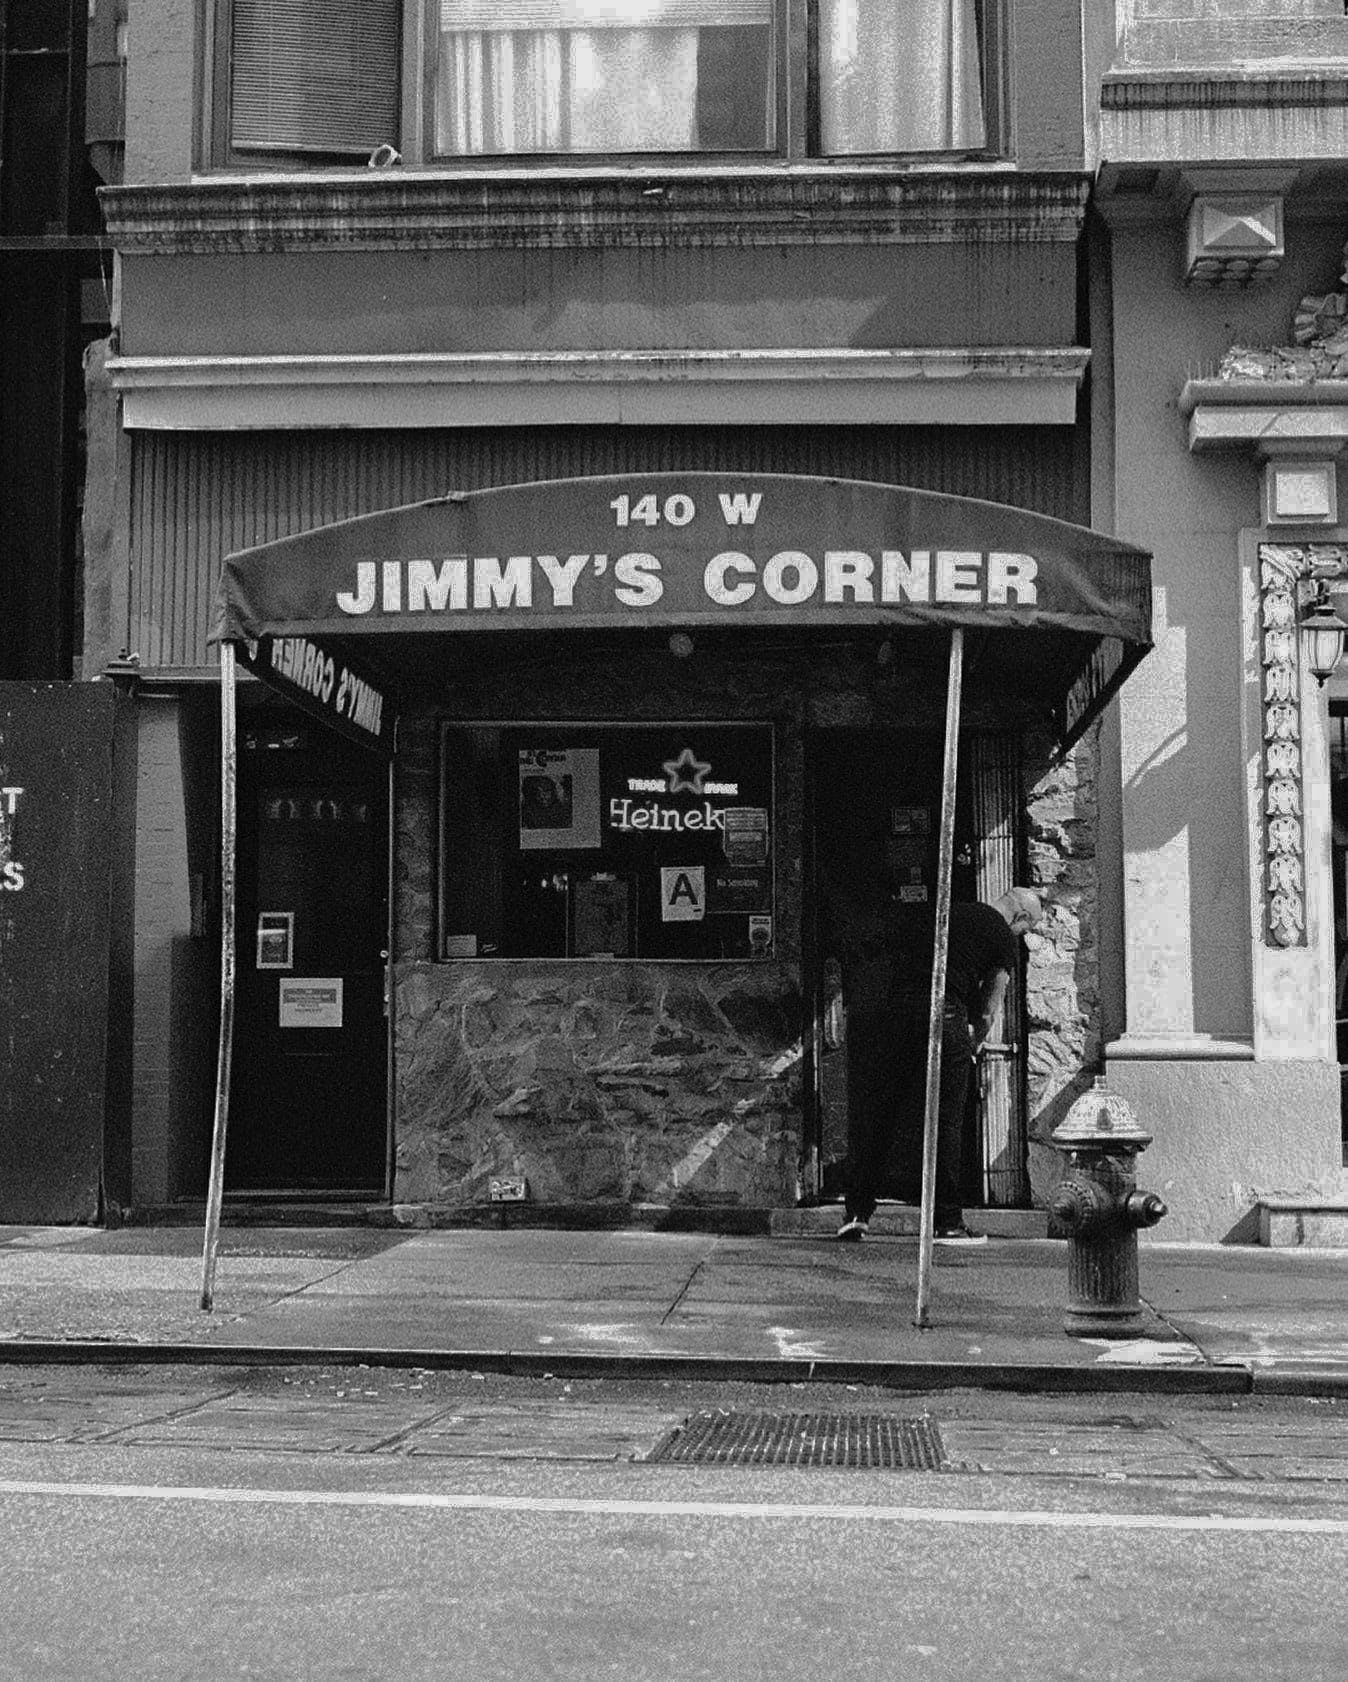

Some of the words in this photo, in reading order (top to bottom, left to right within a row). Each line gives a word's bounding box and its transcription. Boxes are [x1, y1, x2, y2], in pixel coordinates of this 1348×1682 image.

[610, 494, 695, 526] 140
[718, 493, 763, 525] W
[336, 552, 665, 615] JIMMY'S
[703, 551, 1038, 605] CORNER
[0, 787, 25, 814] T
[0, 861, 25, 892] S
[668, 873, 699, 906] A
